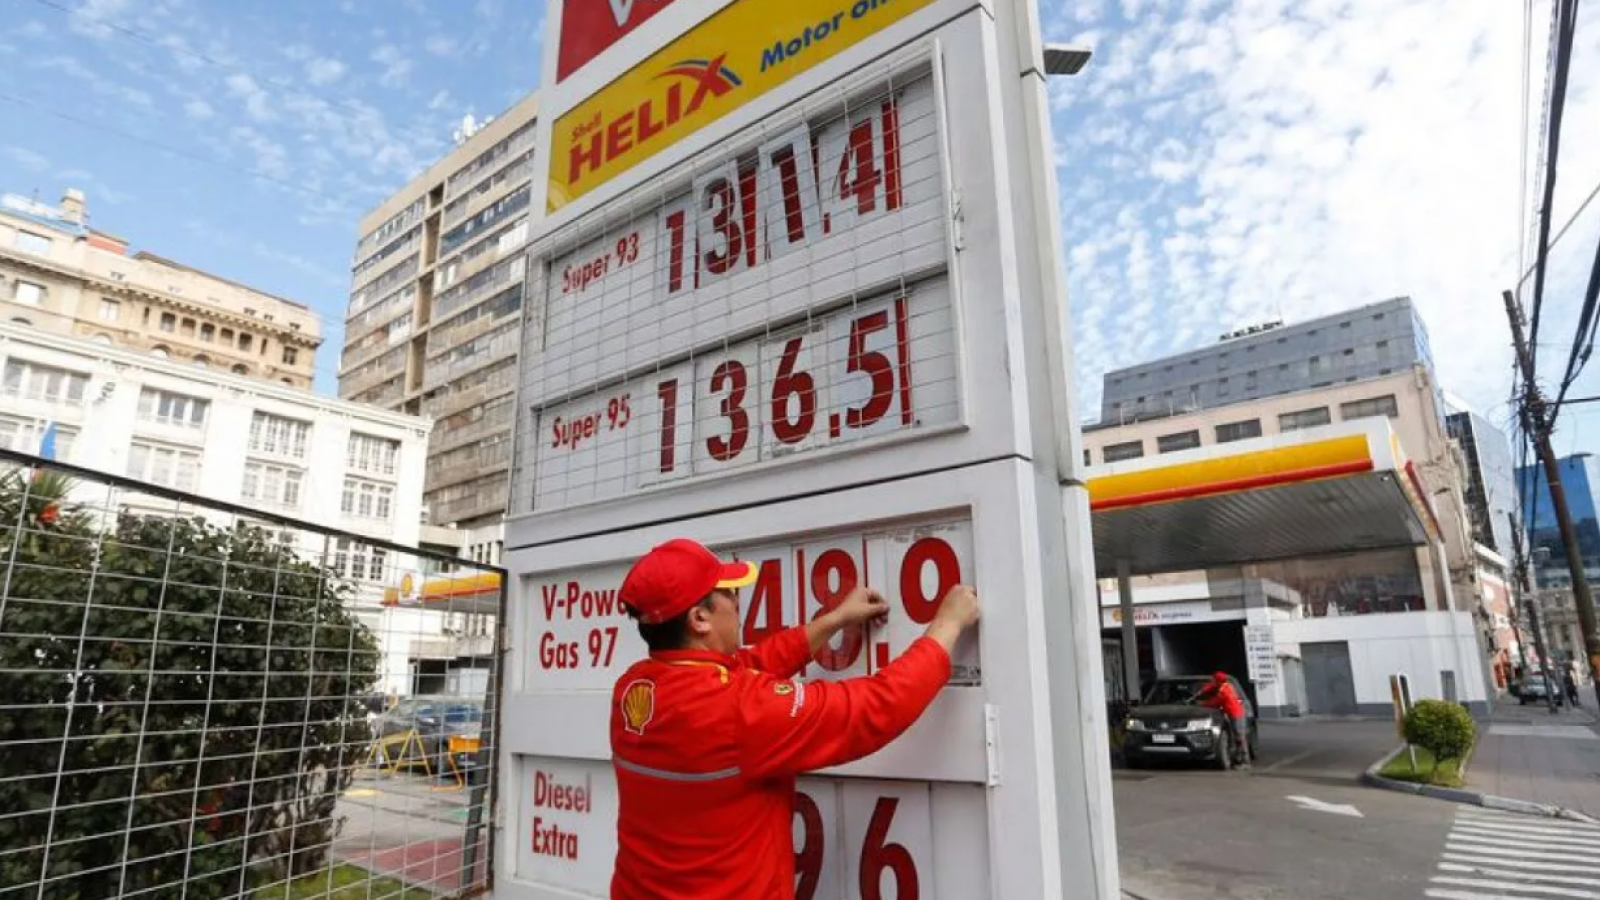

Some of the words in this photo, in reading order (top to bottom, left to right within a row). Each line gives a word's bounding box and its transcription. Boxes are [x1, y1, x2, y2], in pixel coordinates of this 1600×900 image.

[759, 11, 845, 73] Motor
[568, 53, 736, 186] HELIX
[563, 253, 610, 293] Super
[617, 232, 639, 268] 93
[658, 310, 894, 473] 136.5
[552, 412, 601, 450] Super
[608, 393, 630, 431] 95
[542, 581, 627, 621] V-Pow
[540, 631, 578, 669] Gas
[588, 627, 618, 668] 97
[534, 771, 592, 813] Diesel
[533, 816, 578, 860] Extra
